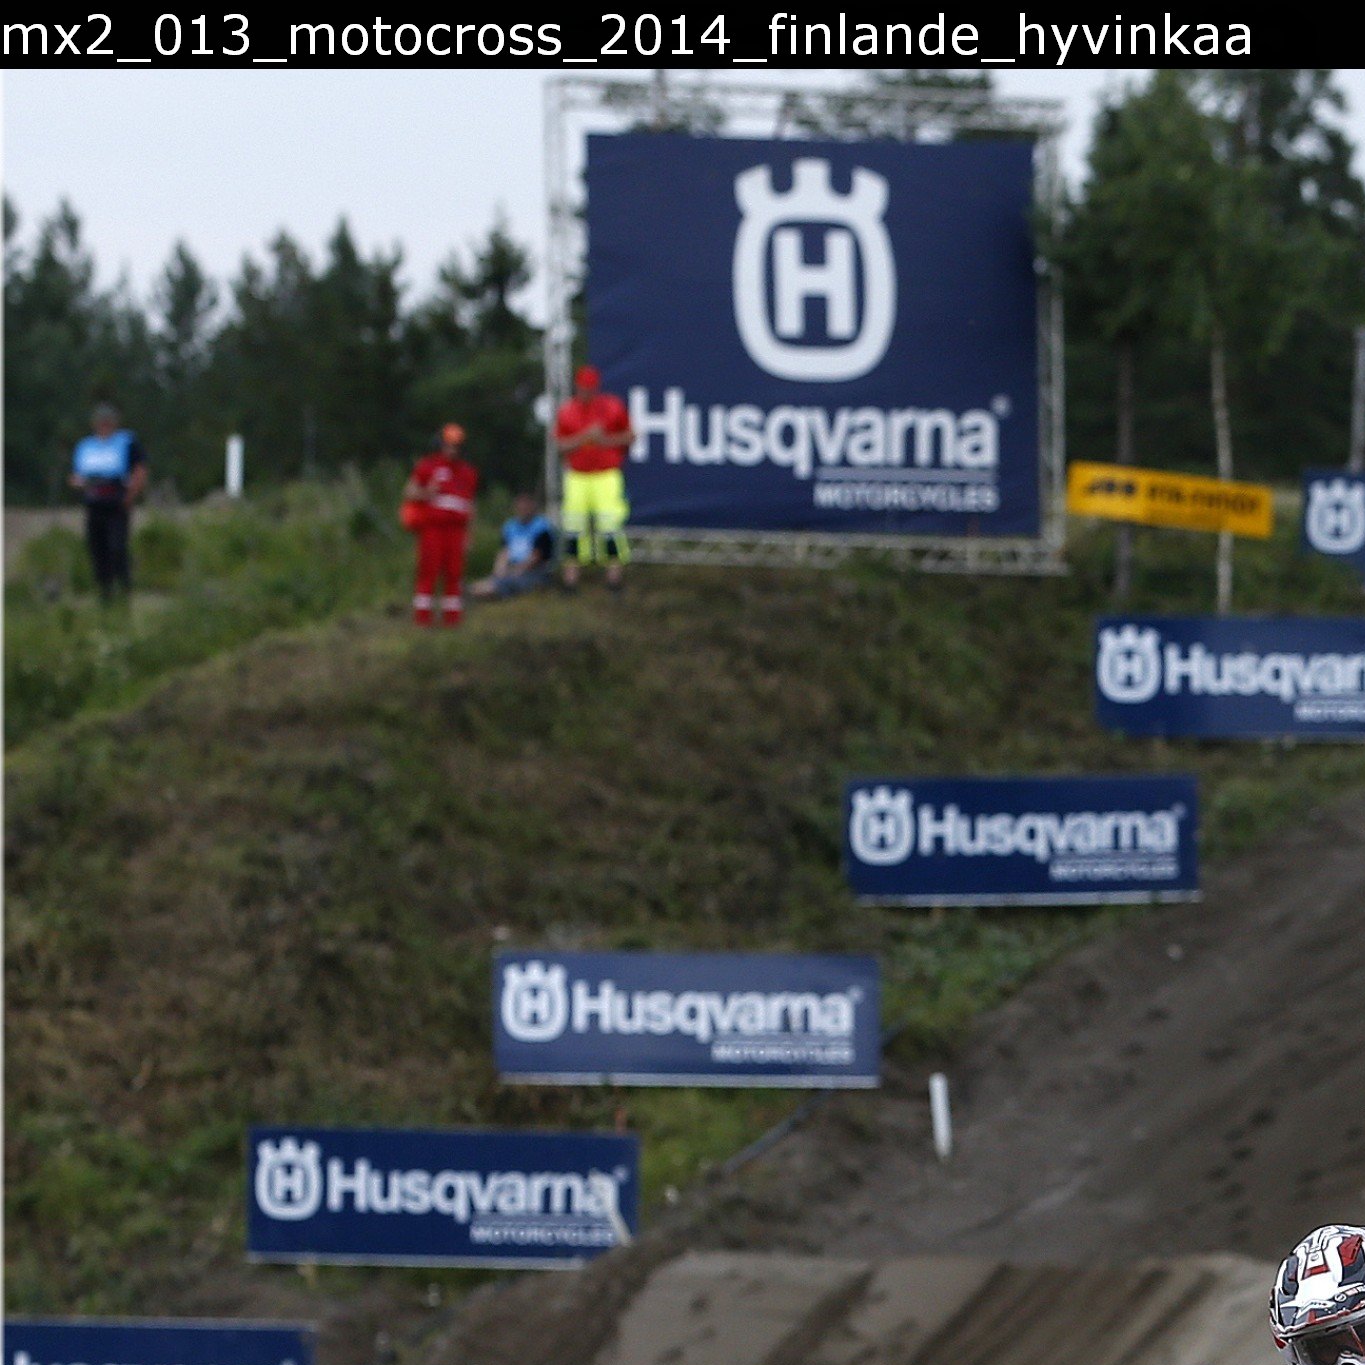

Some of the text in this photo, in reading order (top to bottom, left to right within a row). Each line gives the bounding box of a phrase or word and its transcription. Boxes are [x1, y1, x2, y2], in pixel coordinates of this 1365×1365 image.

[628, 385, 999, 479] Husqvarna
[917, 803, 1178, 863] Husqvarna
[570, 979, 855, 1043] Husqvarna
[325, 1157, 622, 1222] Husqvarna
